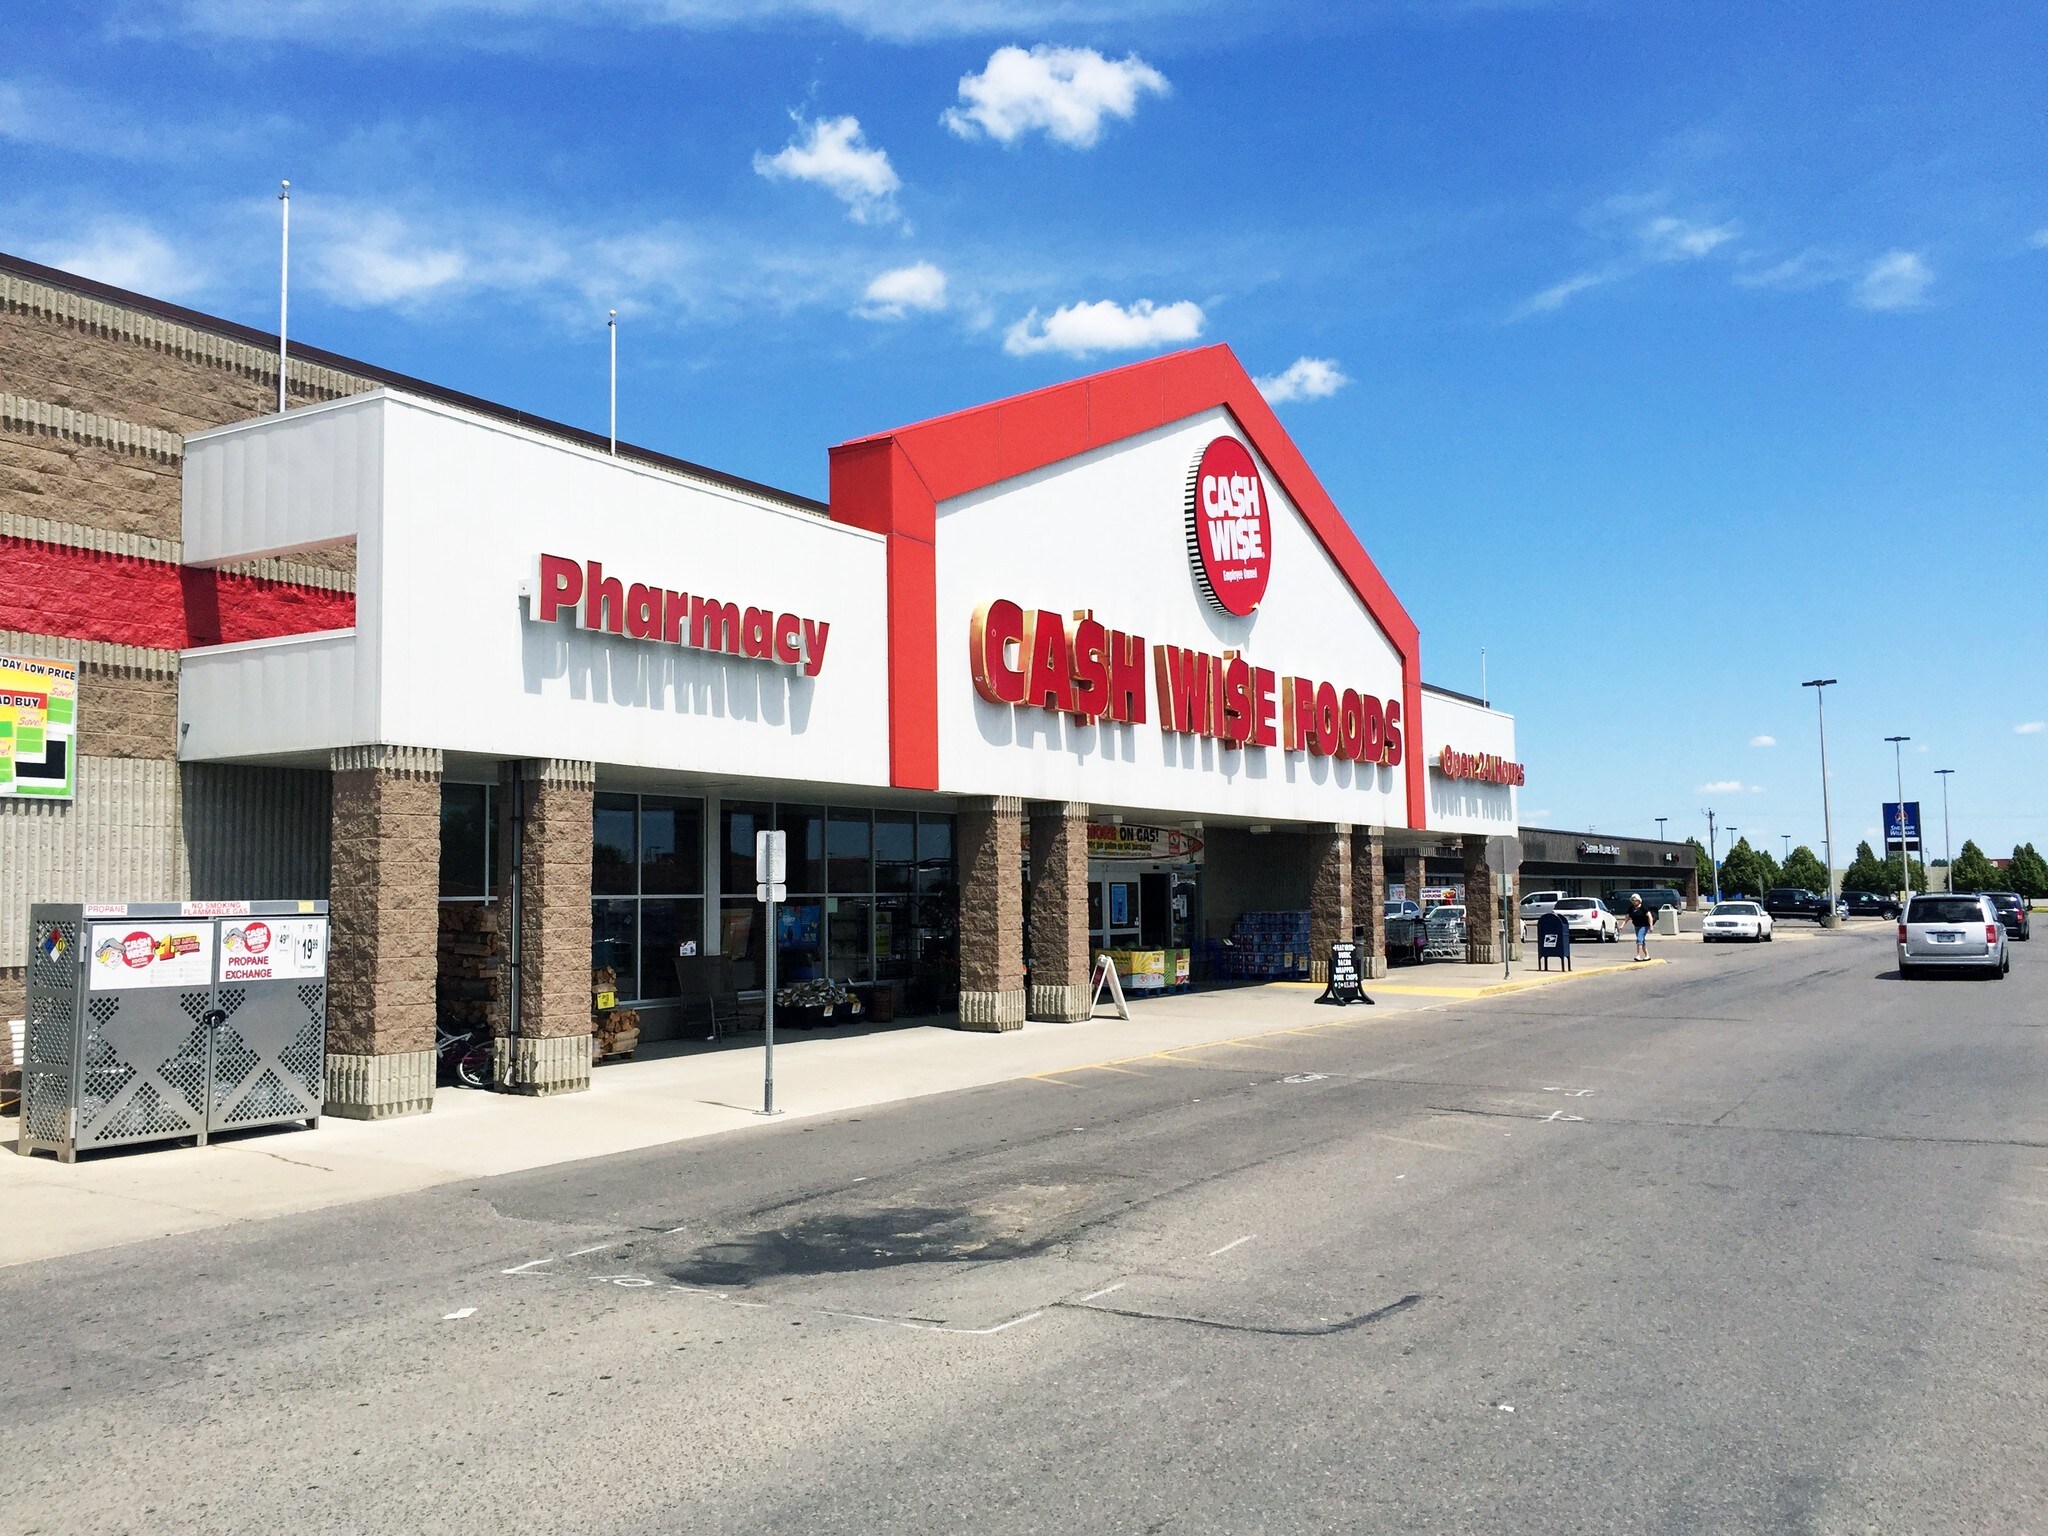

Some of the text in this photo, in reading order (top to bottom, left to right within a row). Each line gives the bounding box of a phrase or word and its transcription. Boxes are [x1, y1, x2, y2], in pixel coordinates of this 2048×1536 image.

[530, 552, 830, 677] Pharmacy
[25, 663, 45, 675] LOW
[48, 667, 75, 680] PRICE
[15, 697, 39, 707] BUY
[1282, 676, 1403, 767] FOODS
[1440, 745, 1525, 787] Open 24 Hours
[1120, 827, 1134, 841] ON
[1137, 828, 1159, 843] GAS!
[228, 956, 269, 966] PROPANE
[225, 969, 272, 979] EXCHANGE
